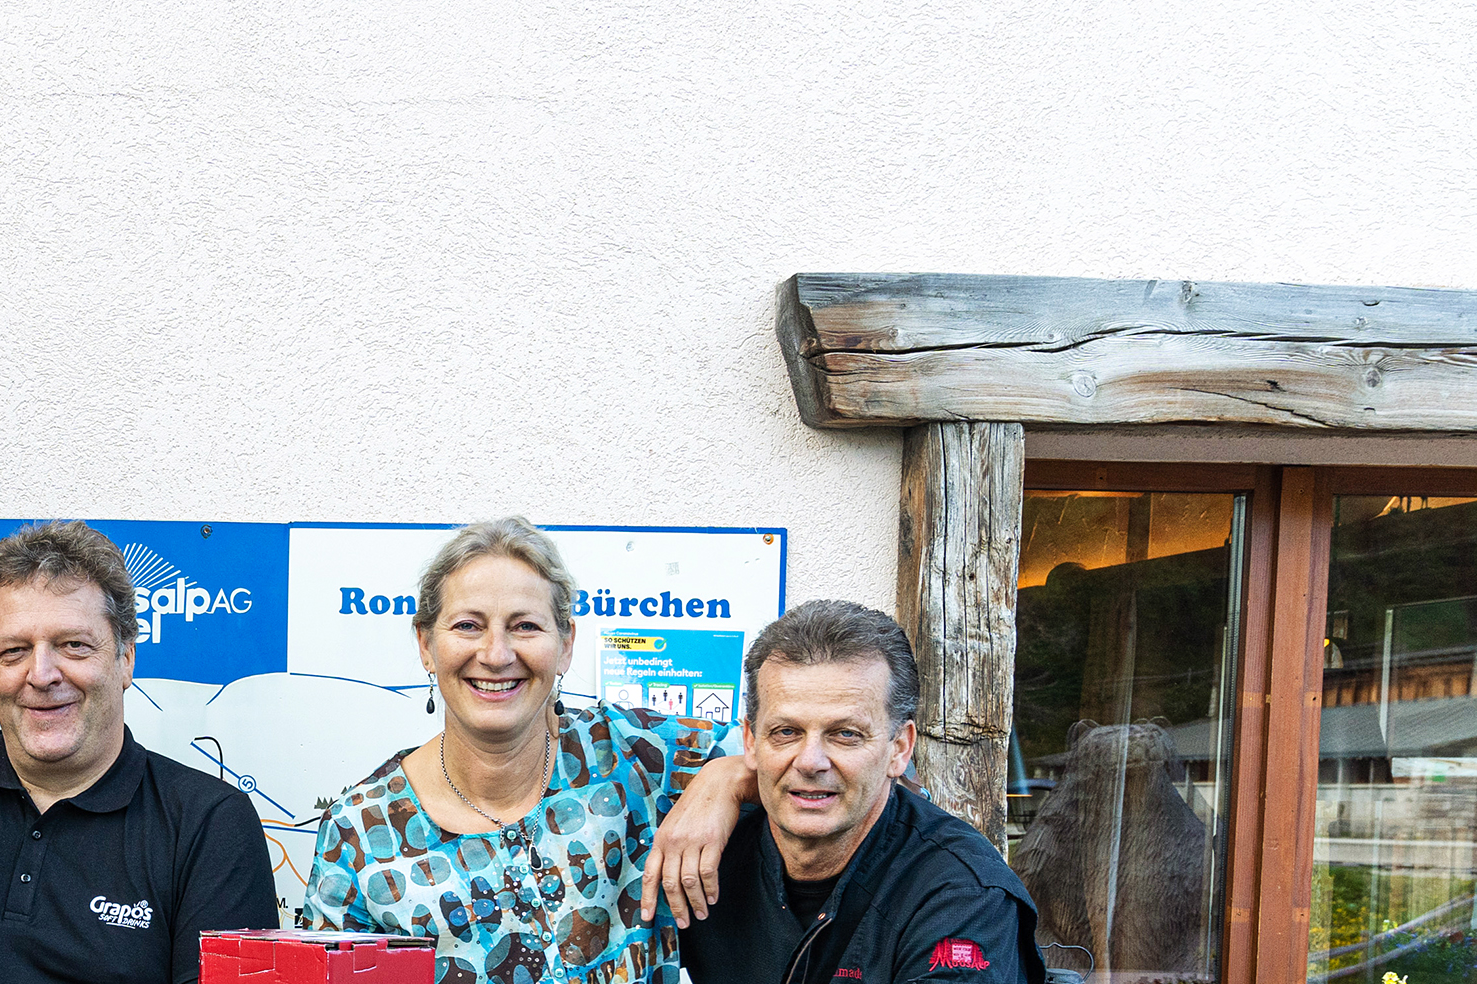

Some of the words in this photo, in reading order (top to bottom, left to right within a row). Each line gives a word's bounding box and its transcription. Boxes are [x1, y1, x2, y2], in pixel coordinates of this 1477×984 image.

[571, 589, 731, 618] Bürchen
[604, 656, 627, 665] Jetzt
[628, 657, 673, 668] unbedingt
[627, 667, 656, 678] Regeln
[657, 667, 702, 677] einhalten:
[98, 914, 117, 922] SOFT
[122, 918, 150, 929] DRINKS
